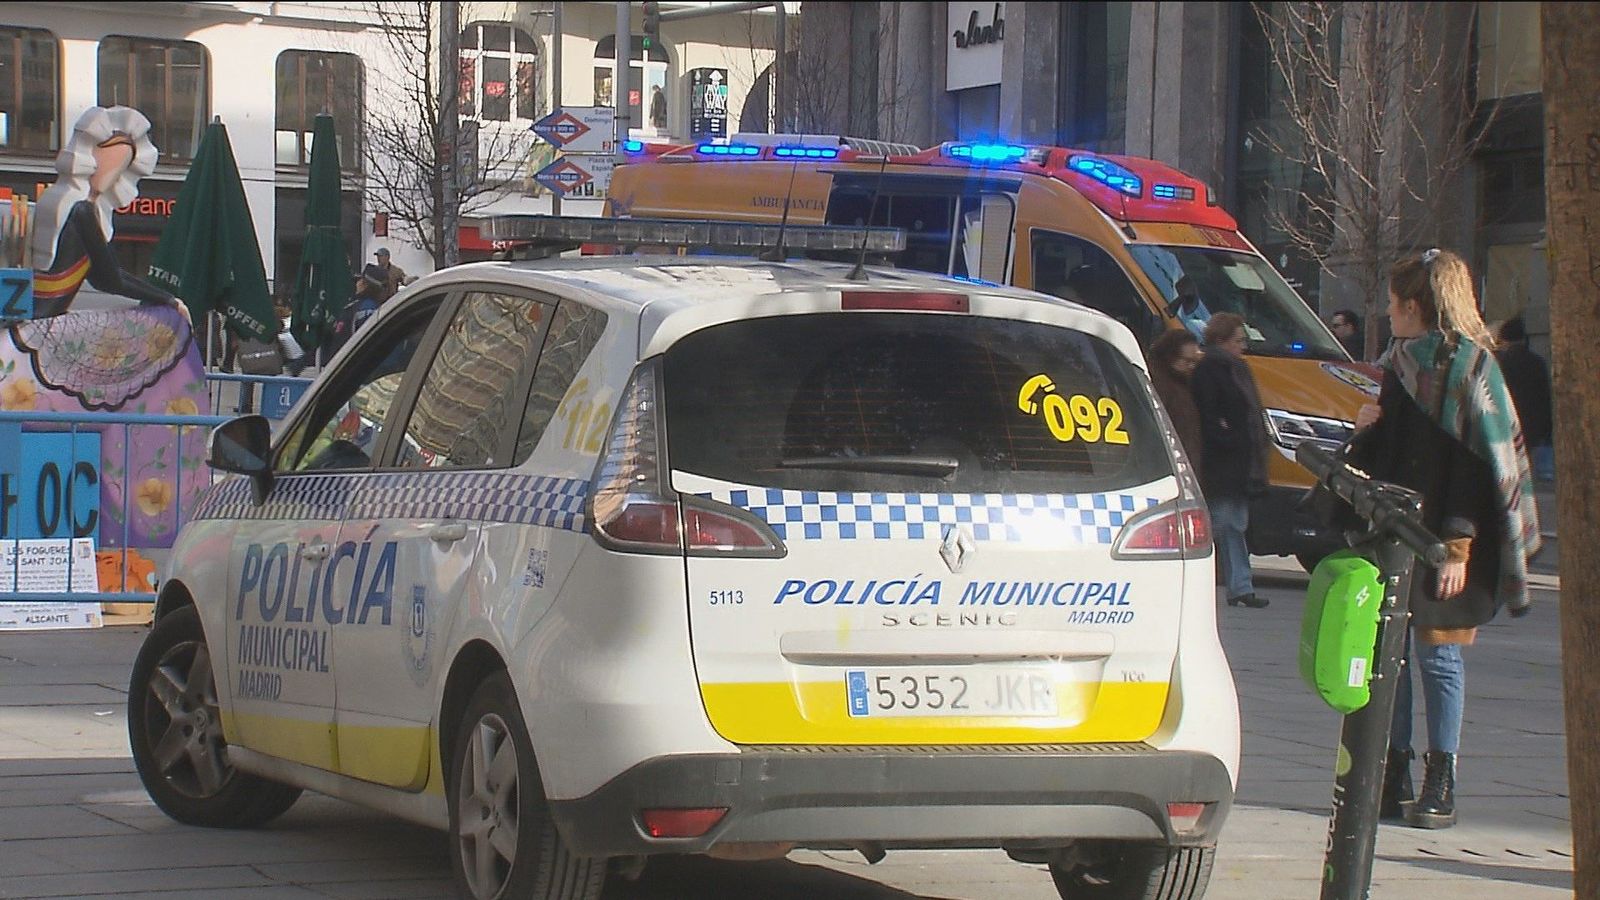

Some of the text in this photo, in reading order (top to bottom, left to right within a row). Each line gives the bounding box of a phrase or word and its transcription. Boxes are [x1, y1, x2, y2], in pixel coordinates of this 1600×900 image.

[148, 265, 181, 288] STAR
[562, 400, 611, 453] 112
[1043, 393, 1130, 445] 092
[21, 557, 46, 566] SANT
[236, 524, 398, 626] POLICÍA
[709, 590, 744, 605] 5113
[774, 573, 1132, 606] POLICÍA MUNICIPAL
[25, 614, 70, 624] ALICANTE
[882, 611, 1018, 627] SCENIC
[1067, 611, 1134, 624] MADRID
[238, 625, 329, 673] MUNICIPAL
[239, 670, 282, 700] MADRID
[855, 674, 1049, 711] E 5352 JKR
